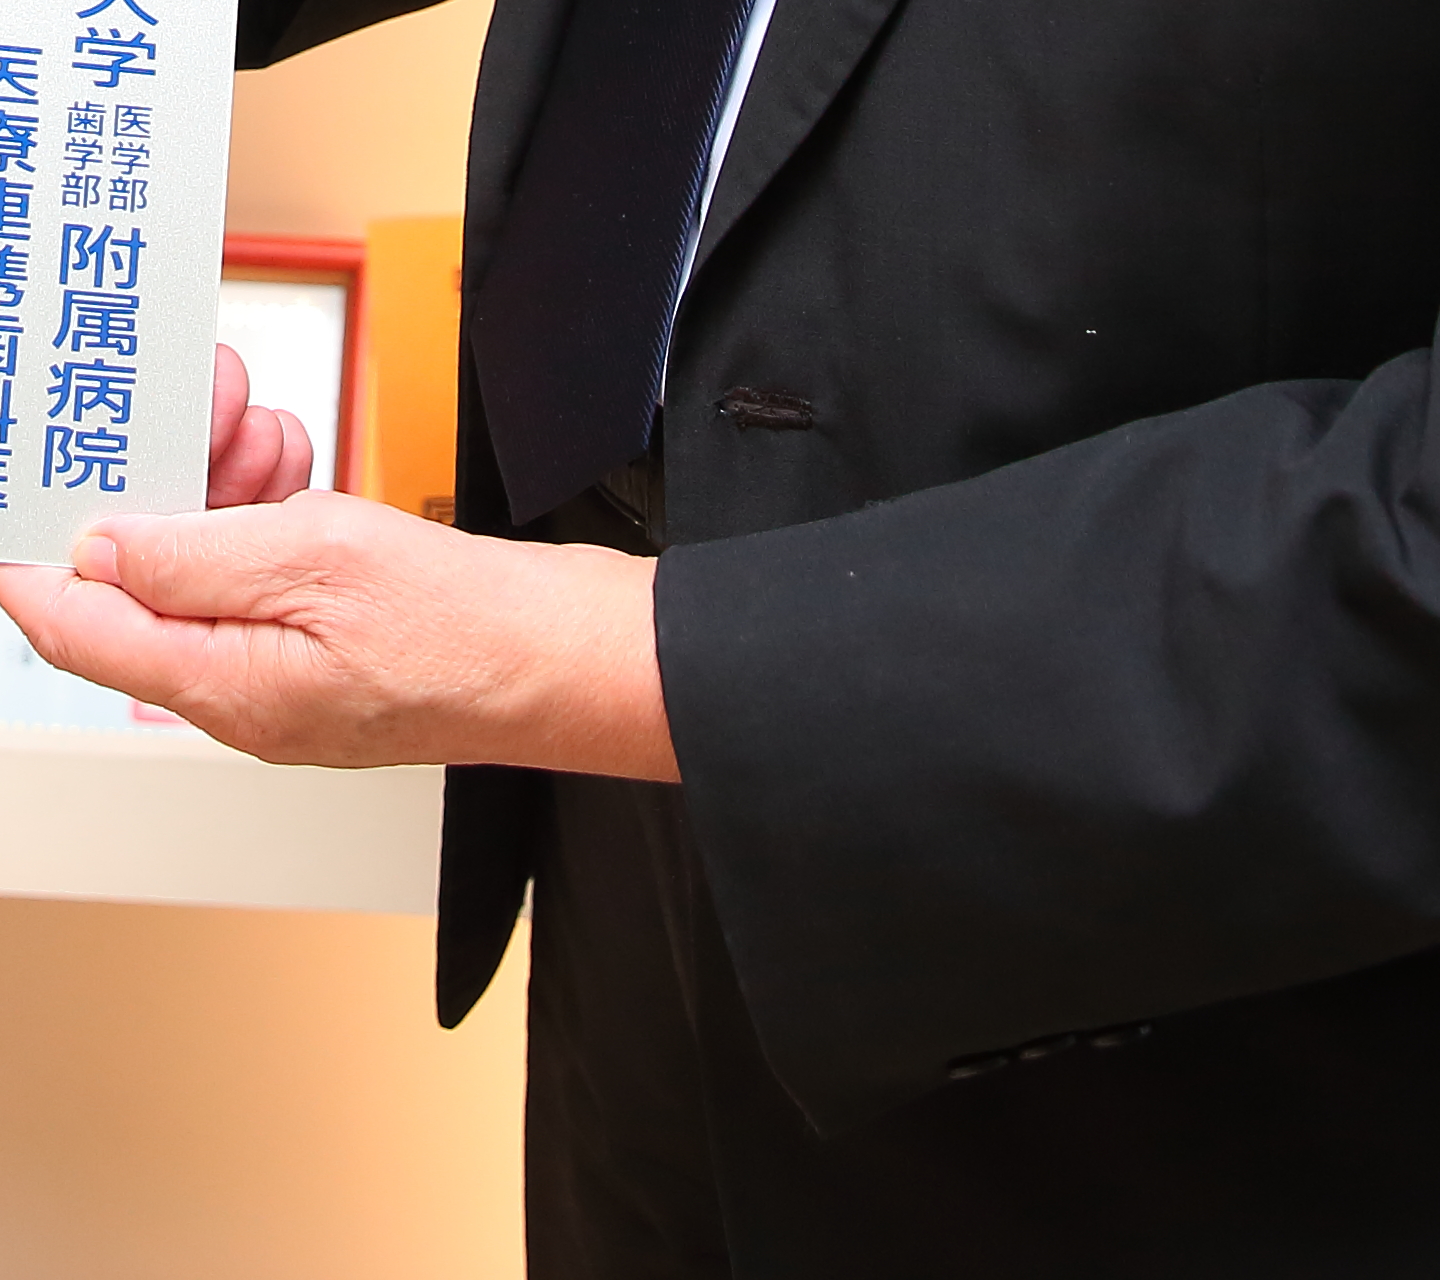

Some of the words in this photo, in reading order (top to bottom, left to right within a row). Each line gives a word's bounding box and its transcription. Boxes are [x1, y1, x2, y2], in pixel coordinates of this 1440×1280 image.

[60, 100, 105, 210] 歯学部
[107, 103, 152, 213] 医学部
[40, 223, 147, 492] 附属病院
